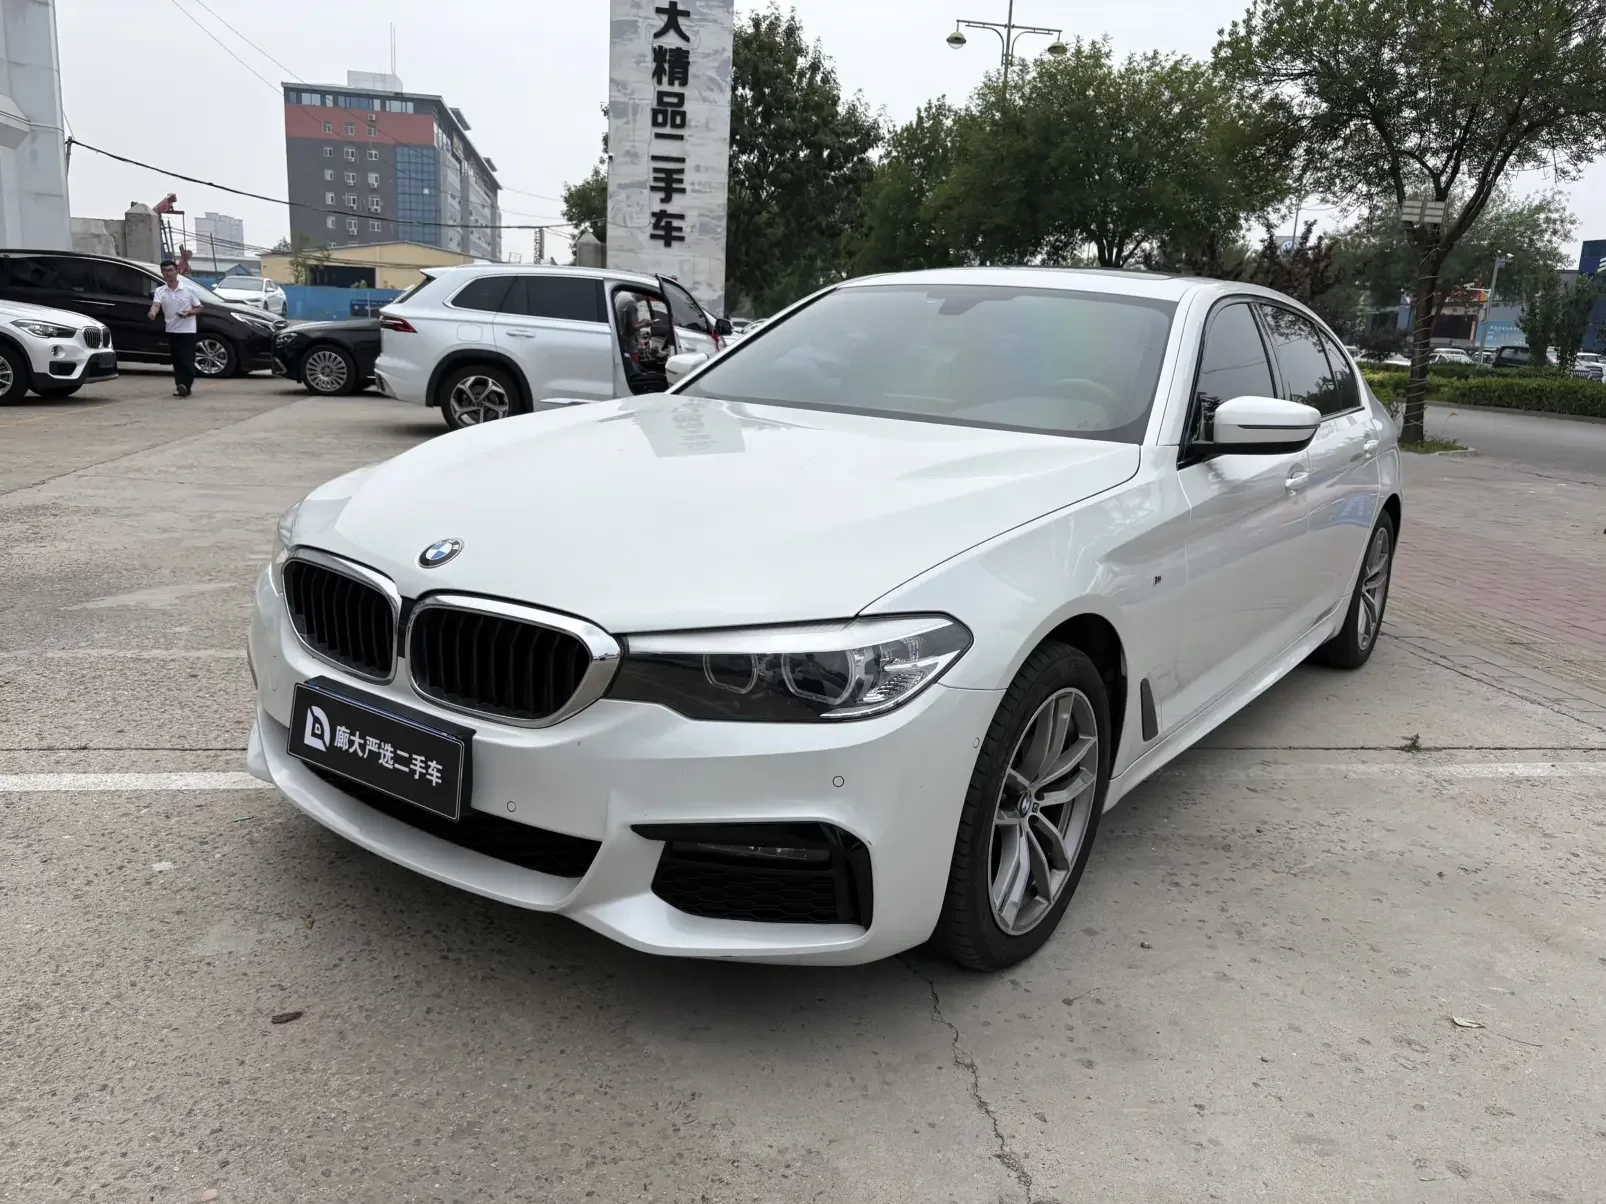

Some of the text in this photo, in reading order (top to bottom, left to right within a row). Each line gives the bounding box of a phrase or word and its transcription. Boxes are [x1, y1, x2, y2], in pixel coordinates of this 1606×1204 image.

[650, 1, 691, 248] 大精品二手车
[334, 725, 443, 787] 廊大严选二手车
